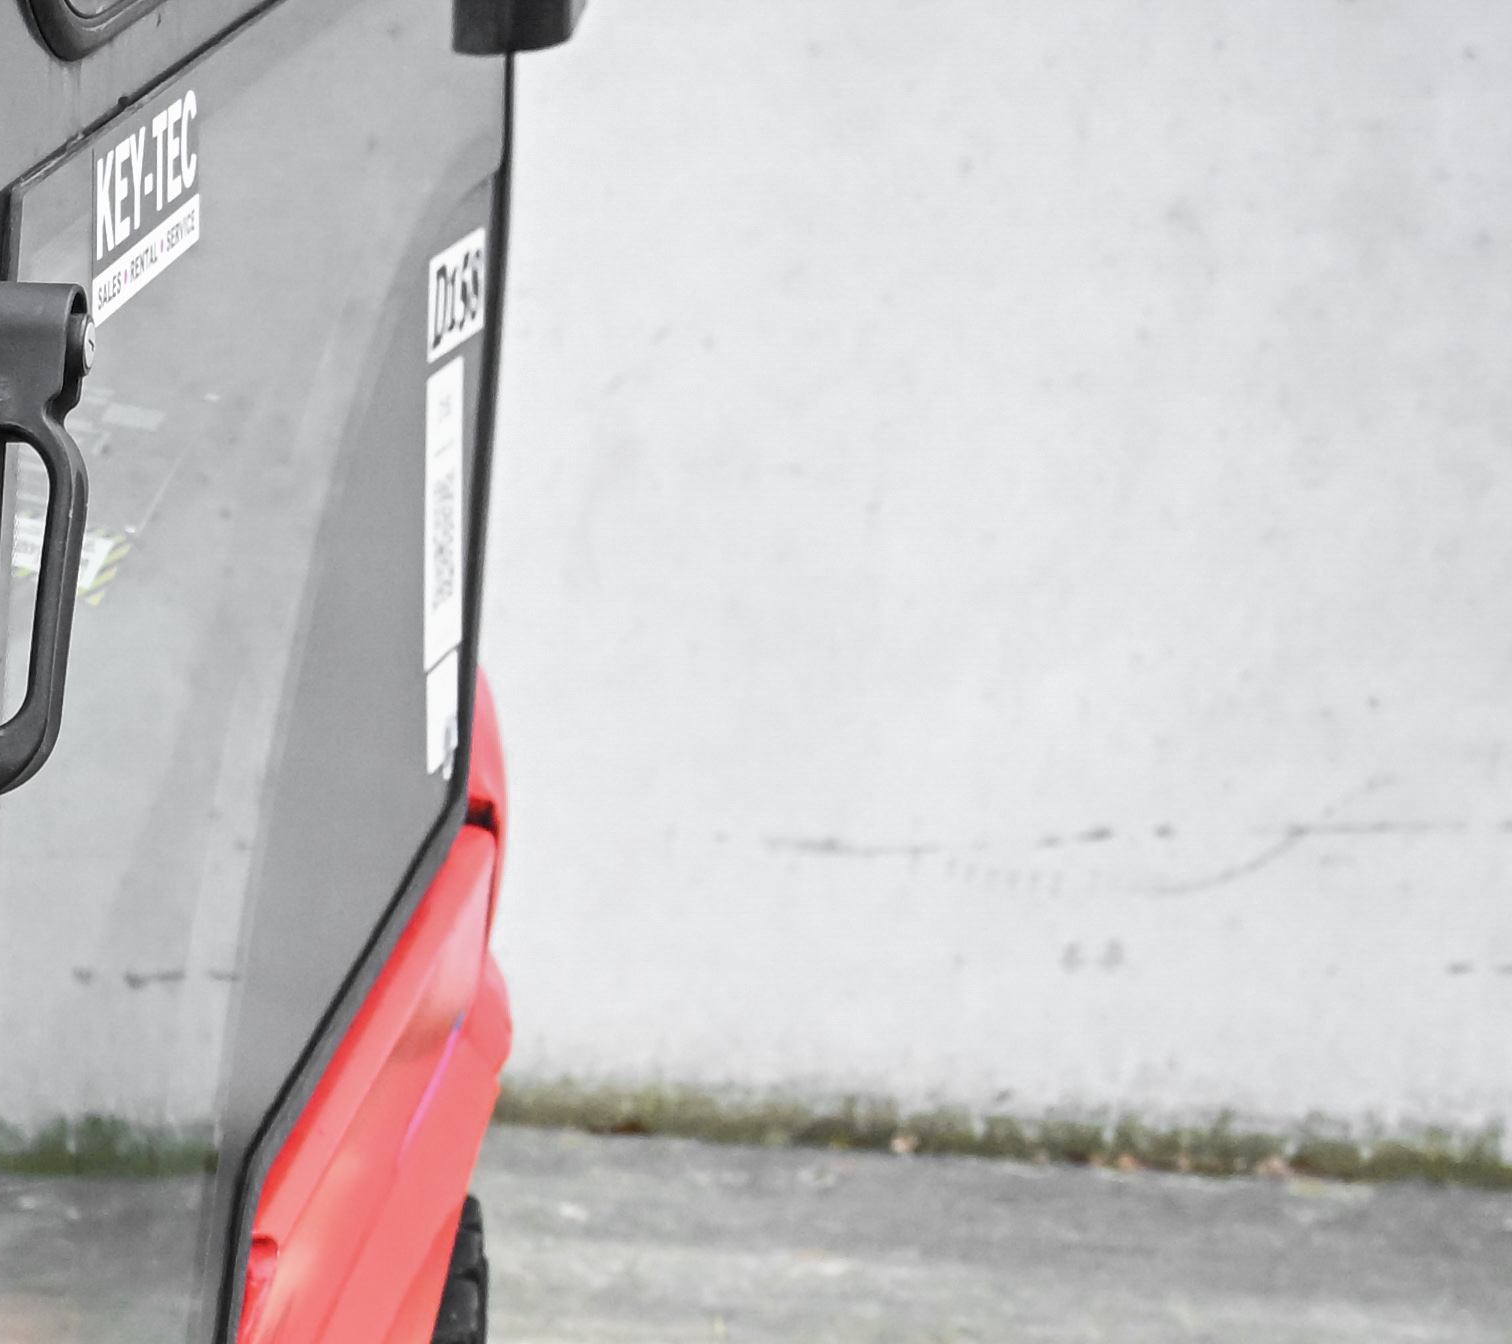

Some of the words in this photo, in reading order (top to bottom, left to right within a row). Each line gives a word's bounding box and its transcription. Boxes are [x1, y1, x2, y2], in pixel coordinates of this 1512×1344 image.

[96, 90, 198, 262] KEY-TEC
[97, 271, 122, 311] SALES
[129, 242, 159, 284] RENTAL
[166, 209, 196, 253] SERVICE
